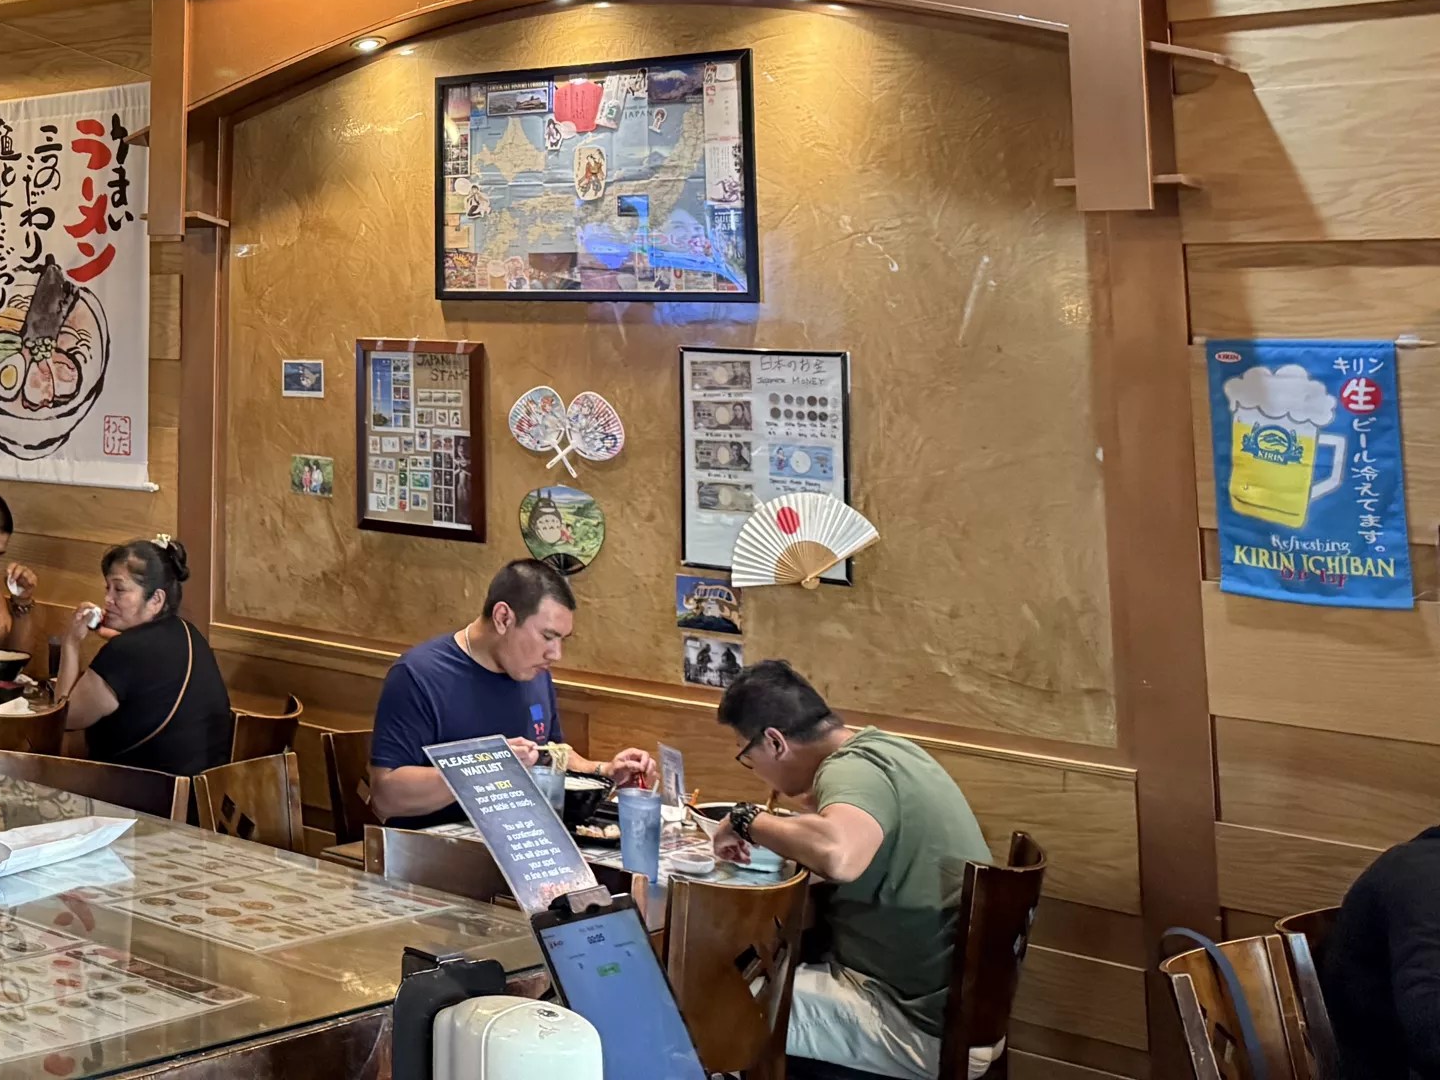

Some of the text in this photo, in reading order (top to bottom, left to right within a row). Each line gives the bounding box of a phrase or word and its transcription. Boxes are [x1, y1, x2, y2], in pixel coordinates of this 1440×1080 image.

[63, 119, 116, 282] ラーメン
[1333, 356, 1384, 375] キリン
[1258, 450, 1284, 462] KIRIN
[1270, 533, 1352, 555] Refreshing
[1233, 544, 1395, 578] KIRIN ICHIBAN
[437, 750, 512, 769] PLEASE SIGN INTO
[460, 762, 504, 777] WAITLIST
[473, 779, 513, 794] We will TEXT
[475, 790, 525, 805] your phone once
[480, 806, 494, 815] your
[493, 801, 510, 811] table
[502, 819, 535, 831] You will get
[511, 828, 545, 840] confirmation
[522, 840, 535, 849] with
[510, 852, 526, 862] Link
[534, 849, 550, 858] show
[528, 861, 542, 870] your
